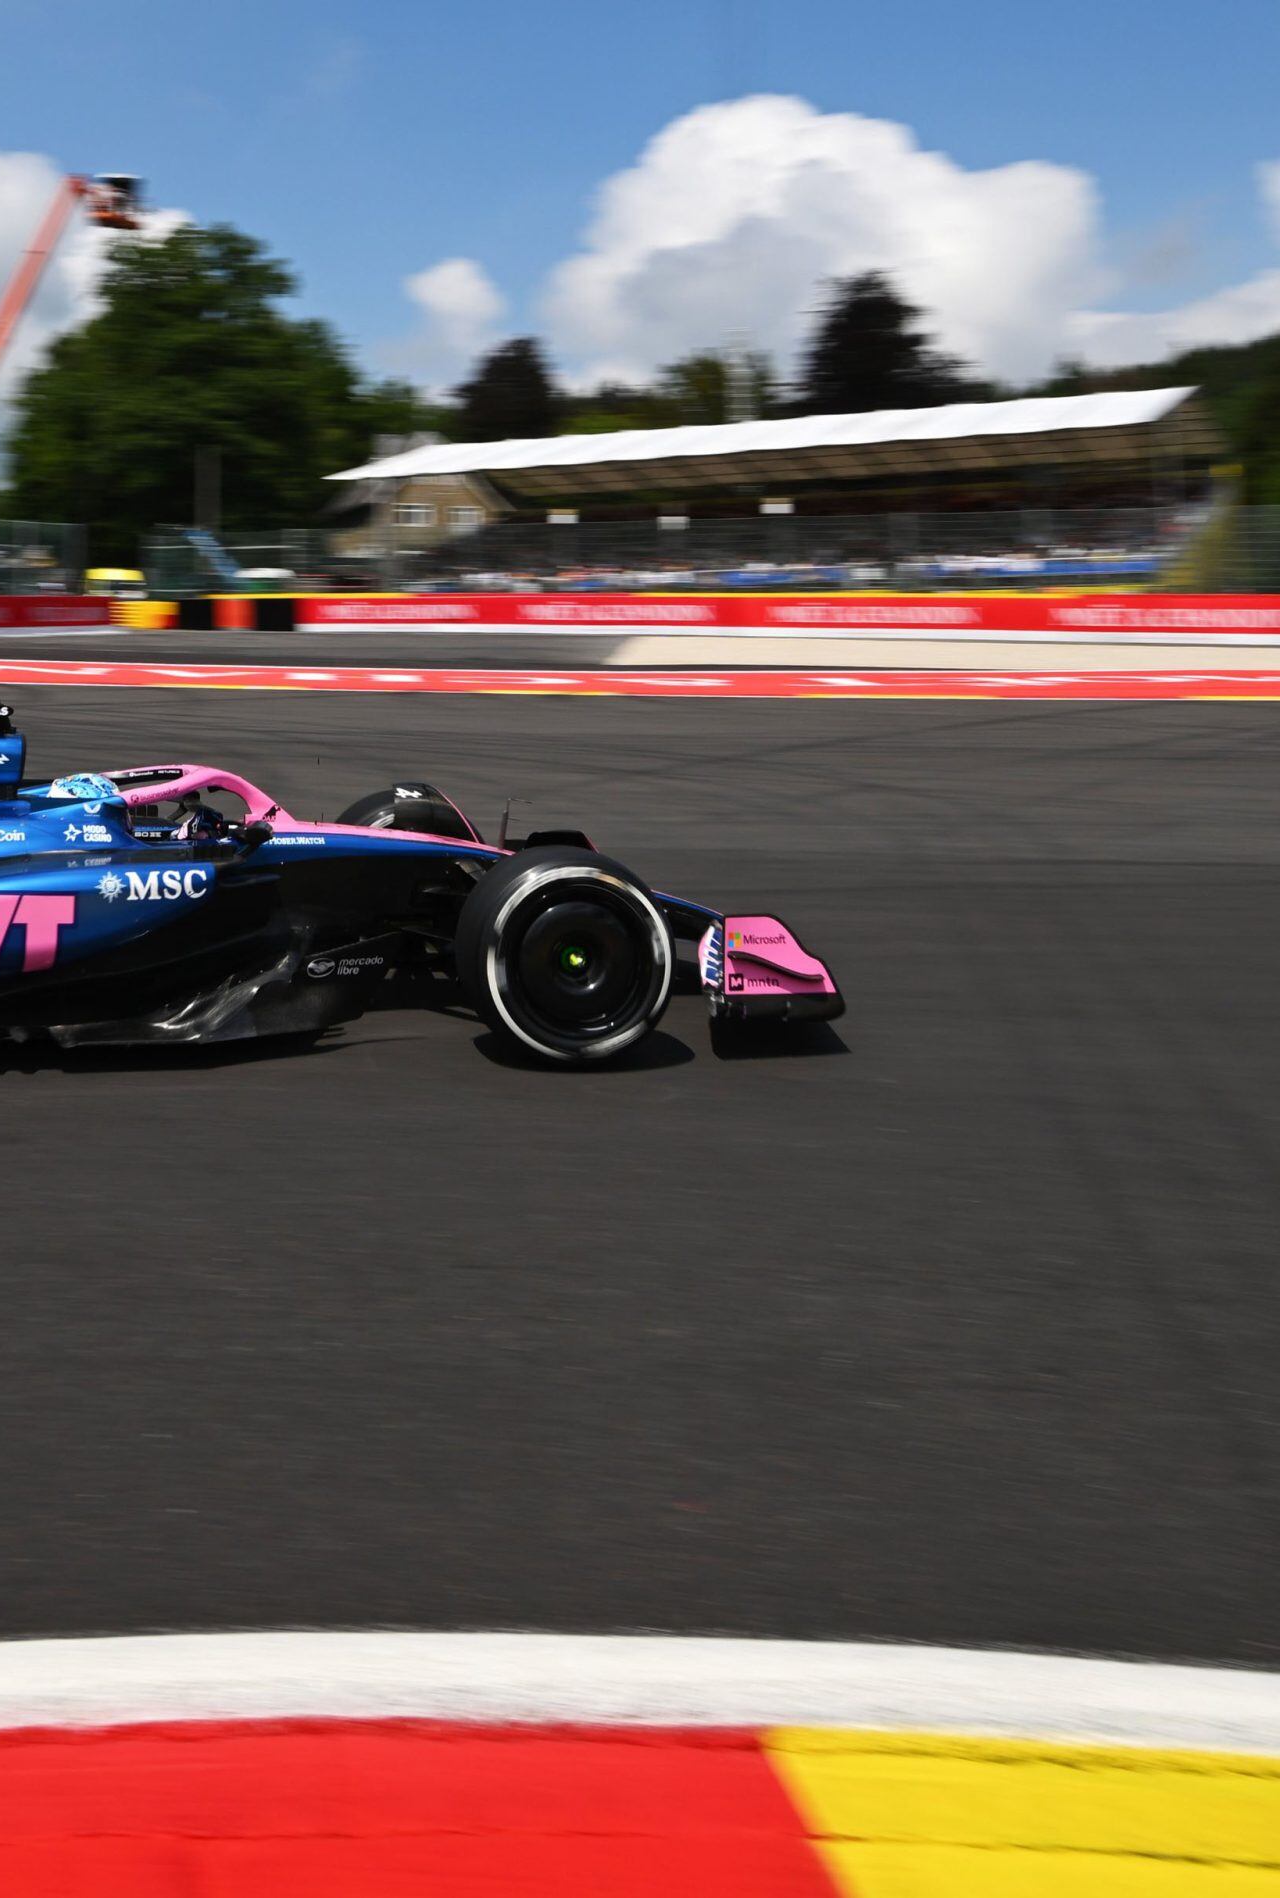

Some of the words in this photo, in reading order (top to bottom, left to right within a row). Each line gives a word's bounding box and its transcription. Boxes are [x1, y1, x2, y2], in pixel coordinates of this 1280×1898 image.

[82, 825, 107, 834] MODO
[82, 833, 112, 843] CASINO
[126, 869, 207, 901] MSC
[743, 934, 786, 945] Microsoft
[339, 955, 384, 967] mercado
[337, 966, 360, 975] libre
